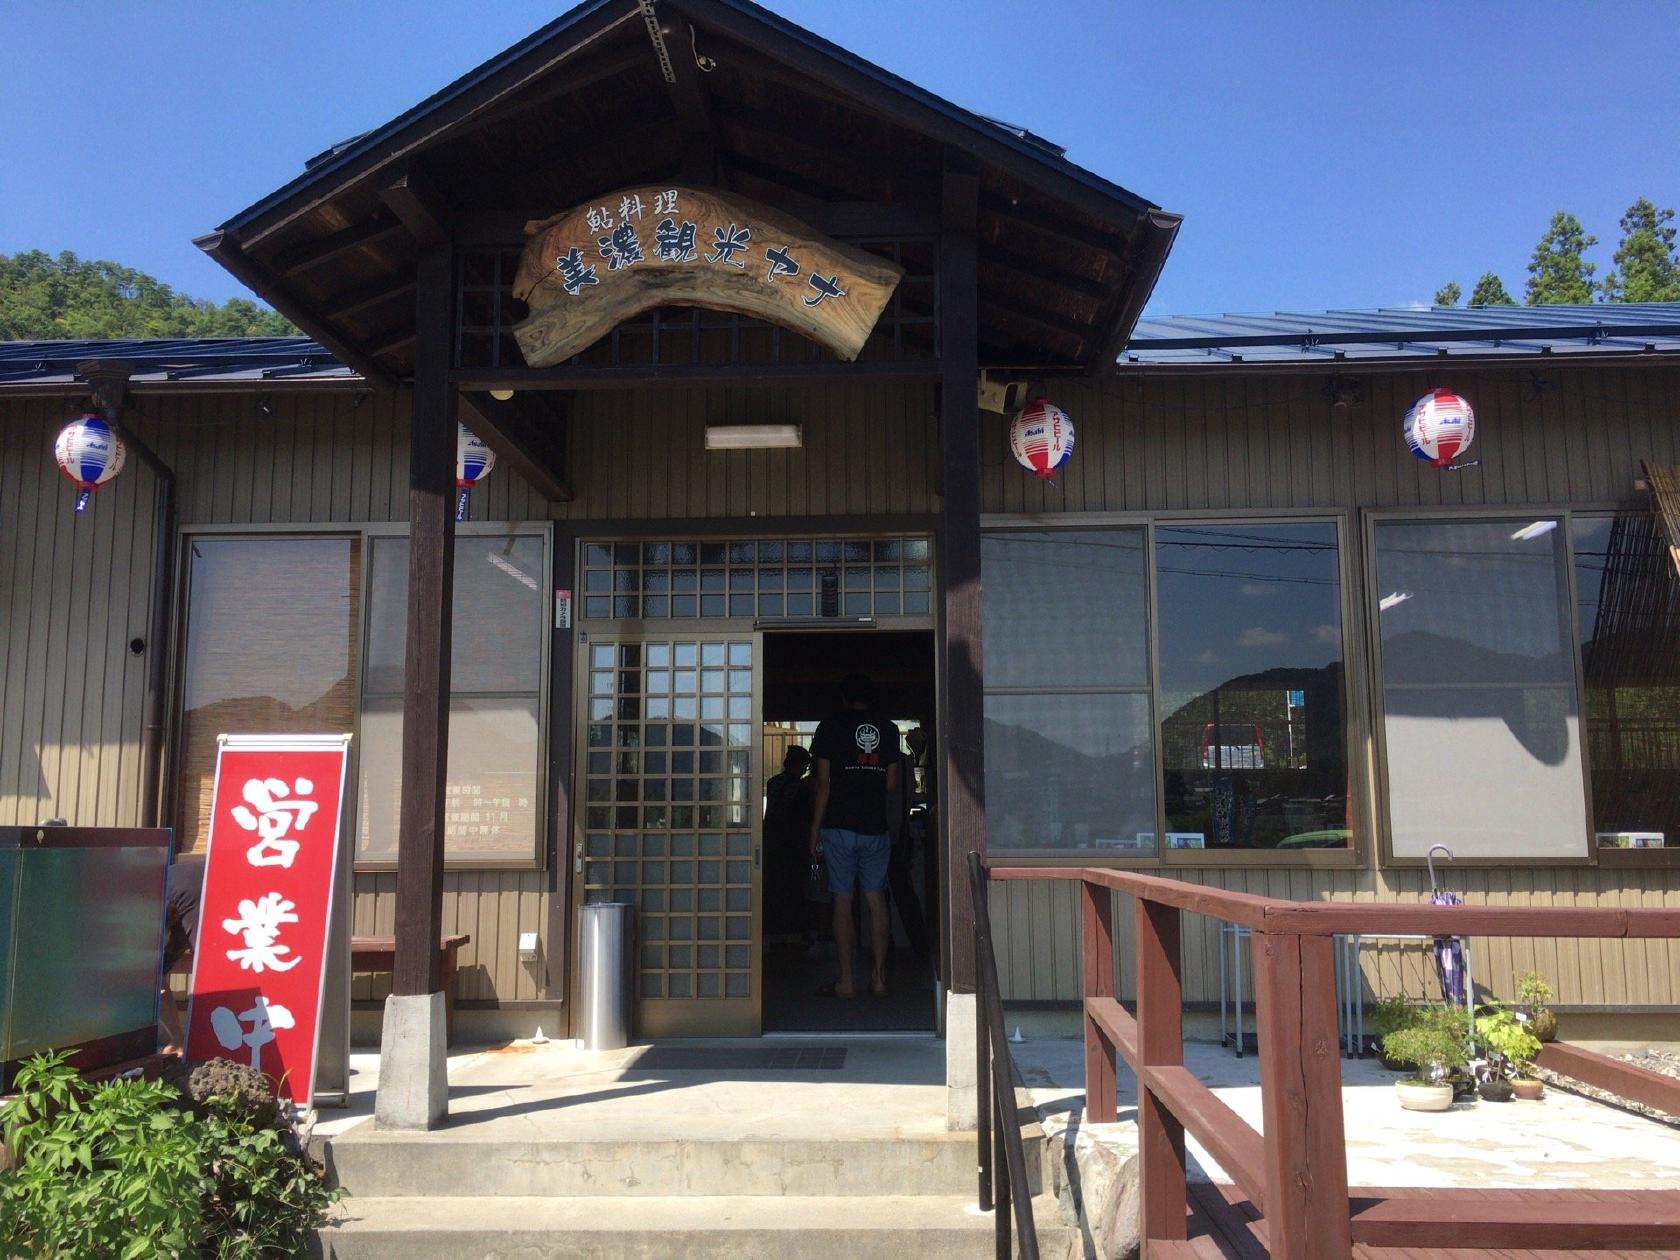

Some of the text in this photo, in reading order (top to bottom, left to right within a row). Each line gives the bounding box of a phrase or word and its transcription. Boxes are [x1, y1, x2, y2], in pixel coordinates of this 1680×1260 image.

[586, 189, 680, 235] 鮎料理
[556, 218, 846, 307] 美濃観光ヤナ
[86, 442, 108, 451] Asahi
[1024, 426, 1045, 437] Asahi
[210, 776, 319, 1073] 営業中
